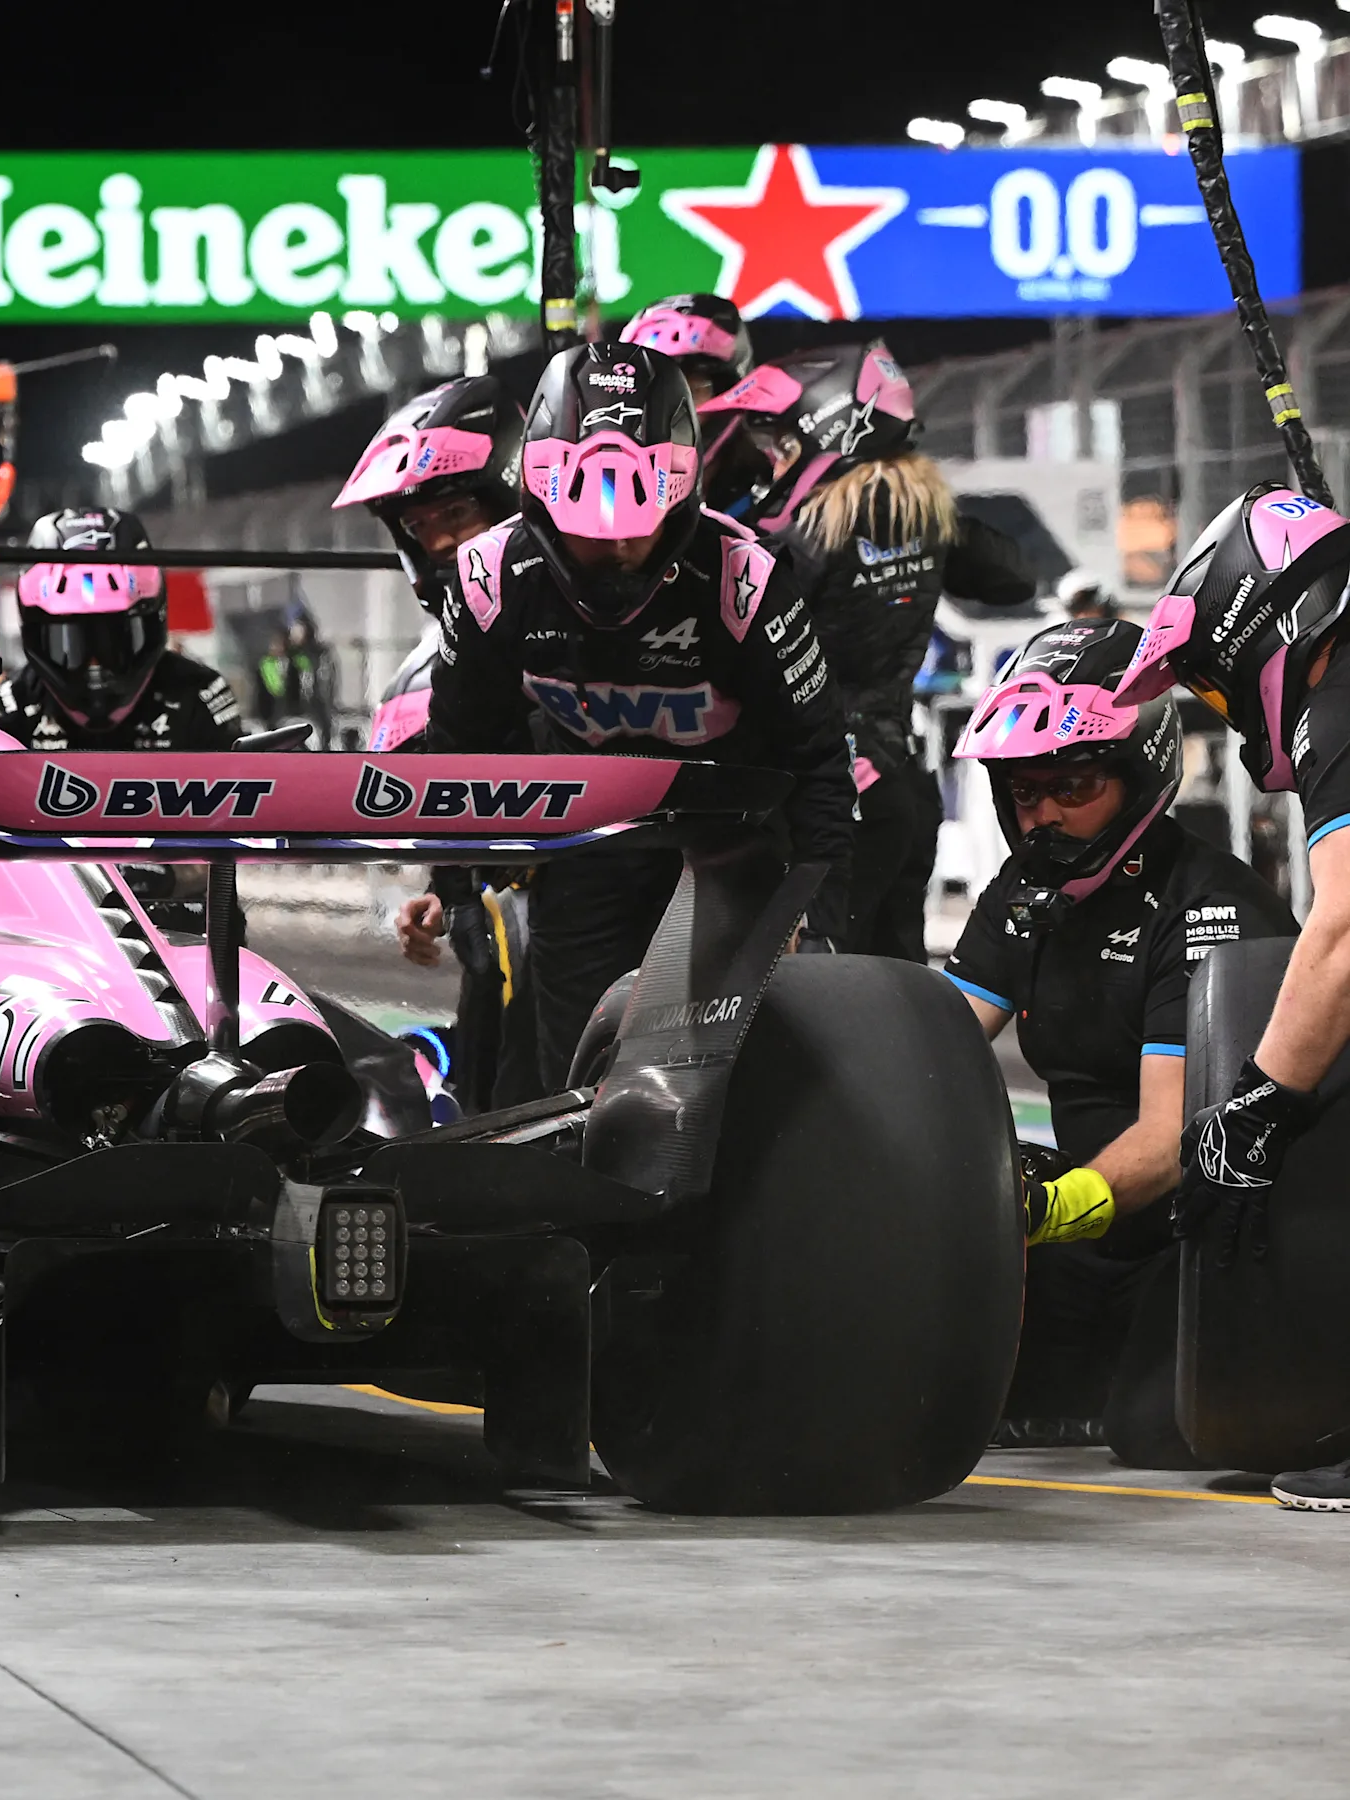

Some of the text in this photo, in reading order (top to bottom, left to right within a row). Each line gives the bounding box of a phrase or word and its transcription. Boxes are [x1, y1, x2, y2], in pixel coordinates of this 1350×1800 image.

[990, 167, 1138, 280] 0.0
[852, 556, 935, 589] ALPINE
[1222, 573, 1257, 631] shamir
[1227, 600, 1275, 658] shamir
[529, 679, 713, 739] BWT
[1060, 706, 1082, 734] BWT
[1153, 702, 1173, 746] shamir
[103, 779, 277, 819] BWT
[416, 779, 589, 820] BWT
[1201, 906, 1237, 921] BWT
[1109, 950, 1135, 964] Castrol
